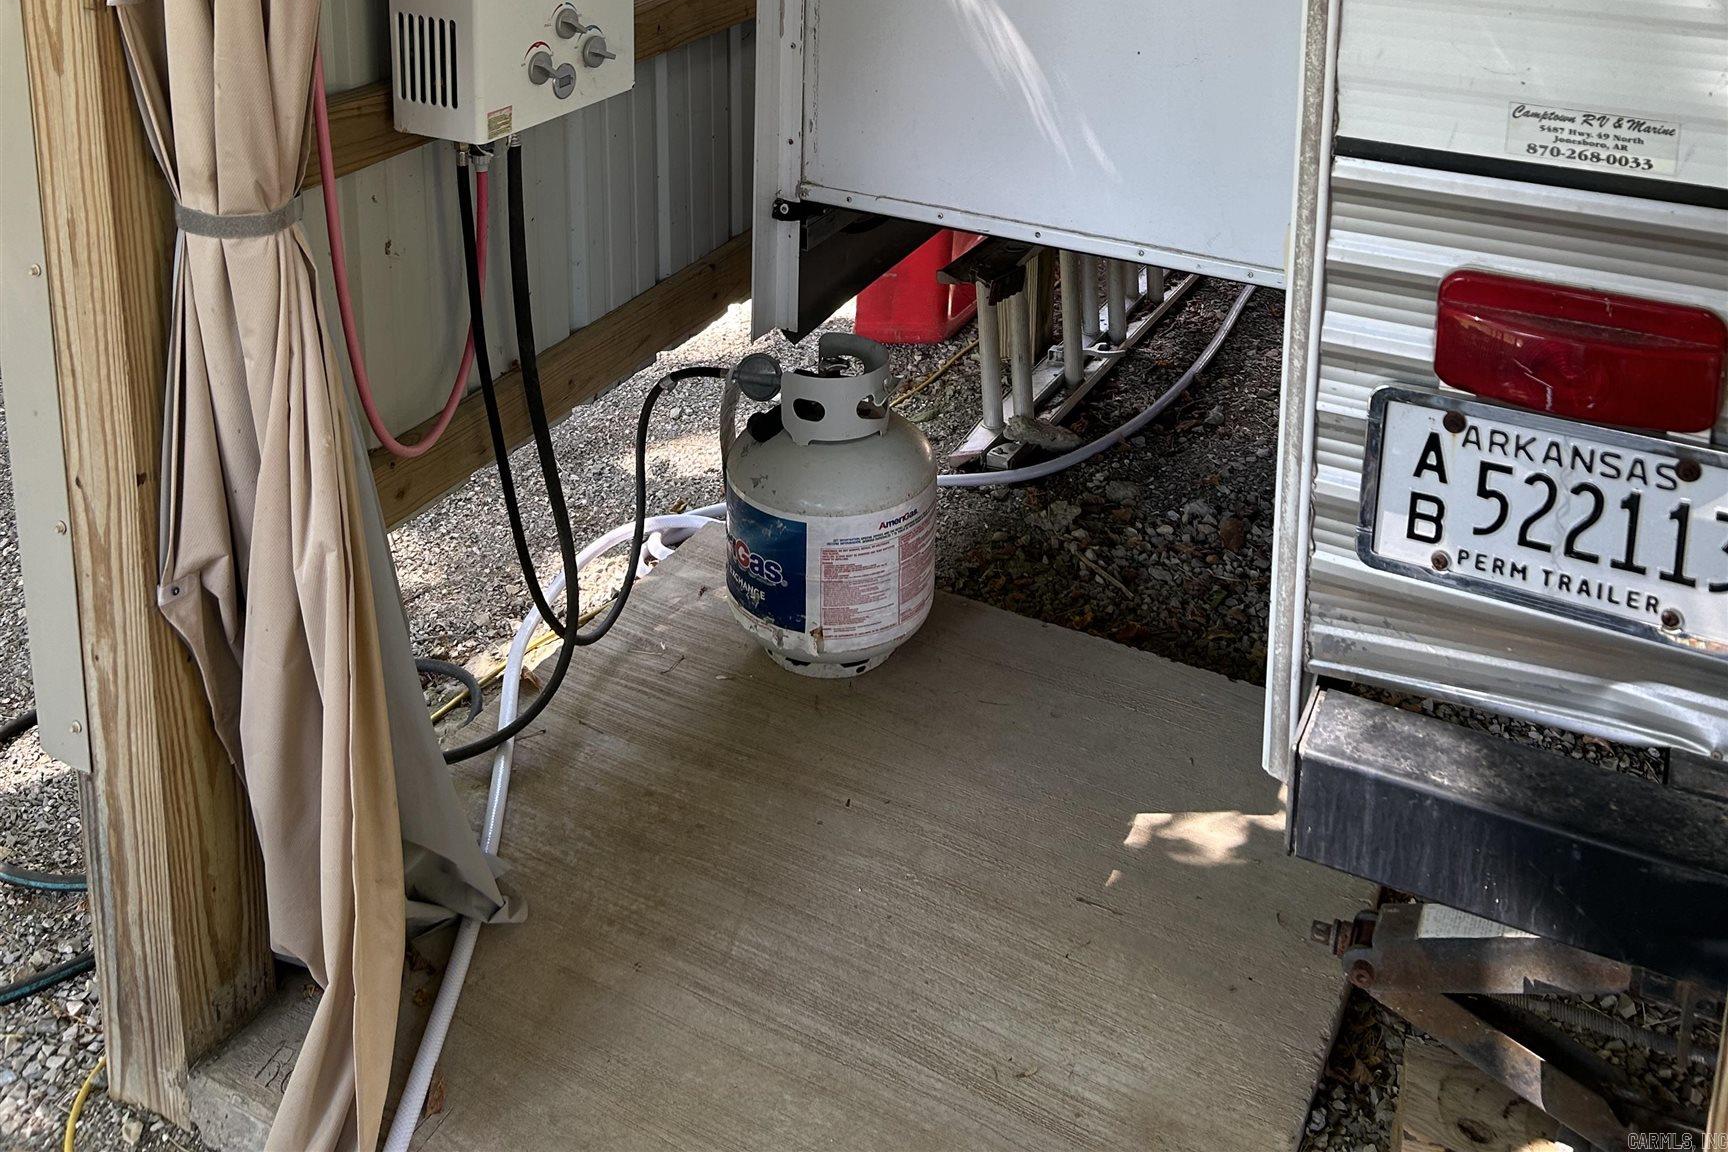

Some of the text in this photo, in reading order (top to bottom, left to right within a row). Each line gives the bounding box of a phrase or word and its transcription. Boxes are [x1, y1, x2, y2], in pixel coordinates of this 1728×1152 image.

[1512, 104, 1676, 137] Camptown RV & Marine
[1552, 135, 1629, 152] Jonesboro, AR
[1568, 128, 1595, 140] Hwy.
[1597, 132, 1610, 141] 49
[1613, 134, 1645, 145] North
[1526, 142, 1654, 171] 870-268-0033
[1461, 424, 1679, 491] ARKANSAS
[878, 508, 918, 530] AmeriGas
[1456, 548, 1660, 615] PERM TRAILER
